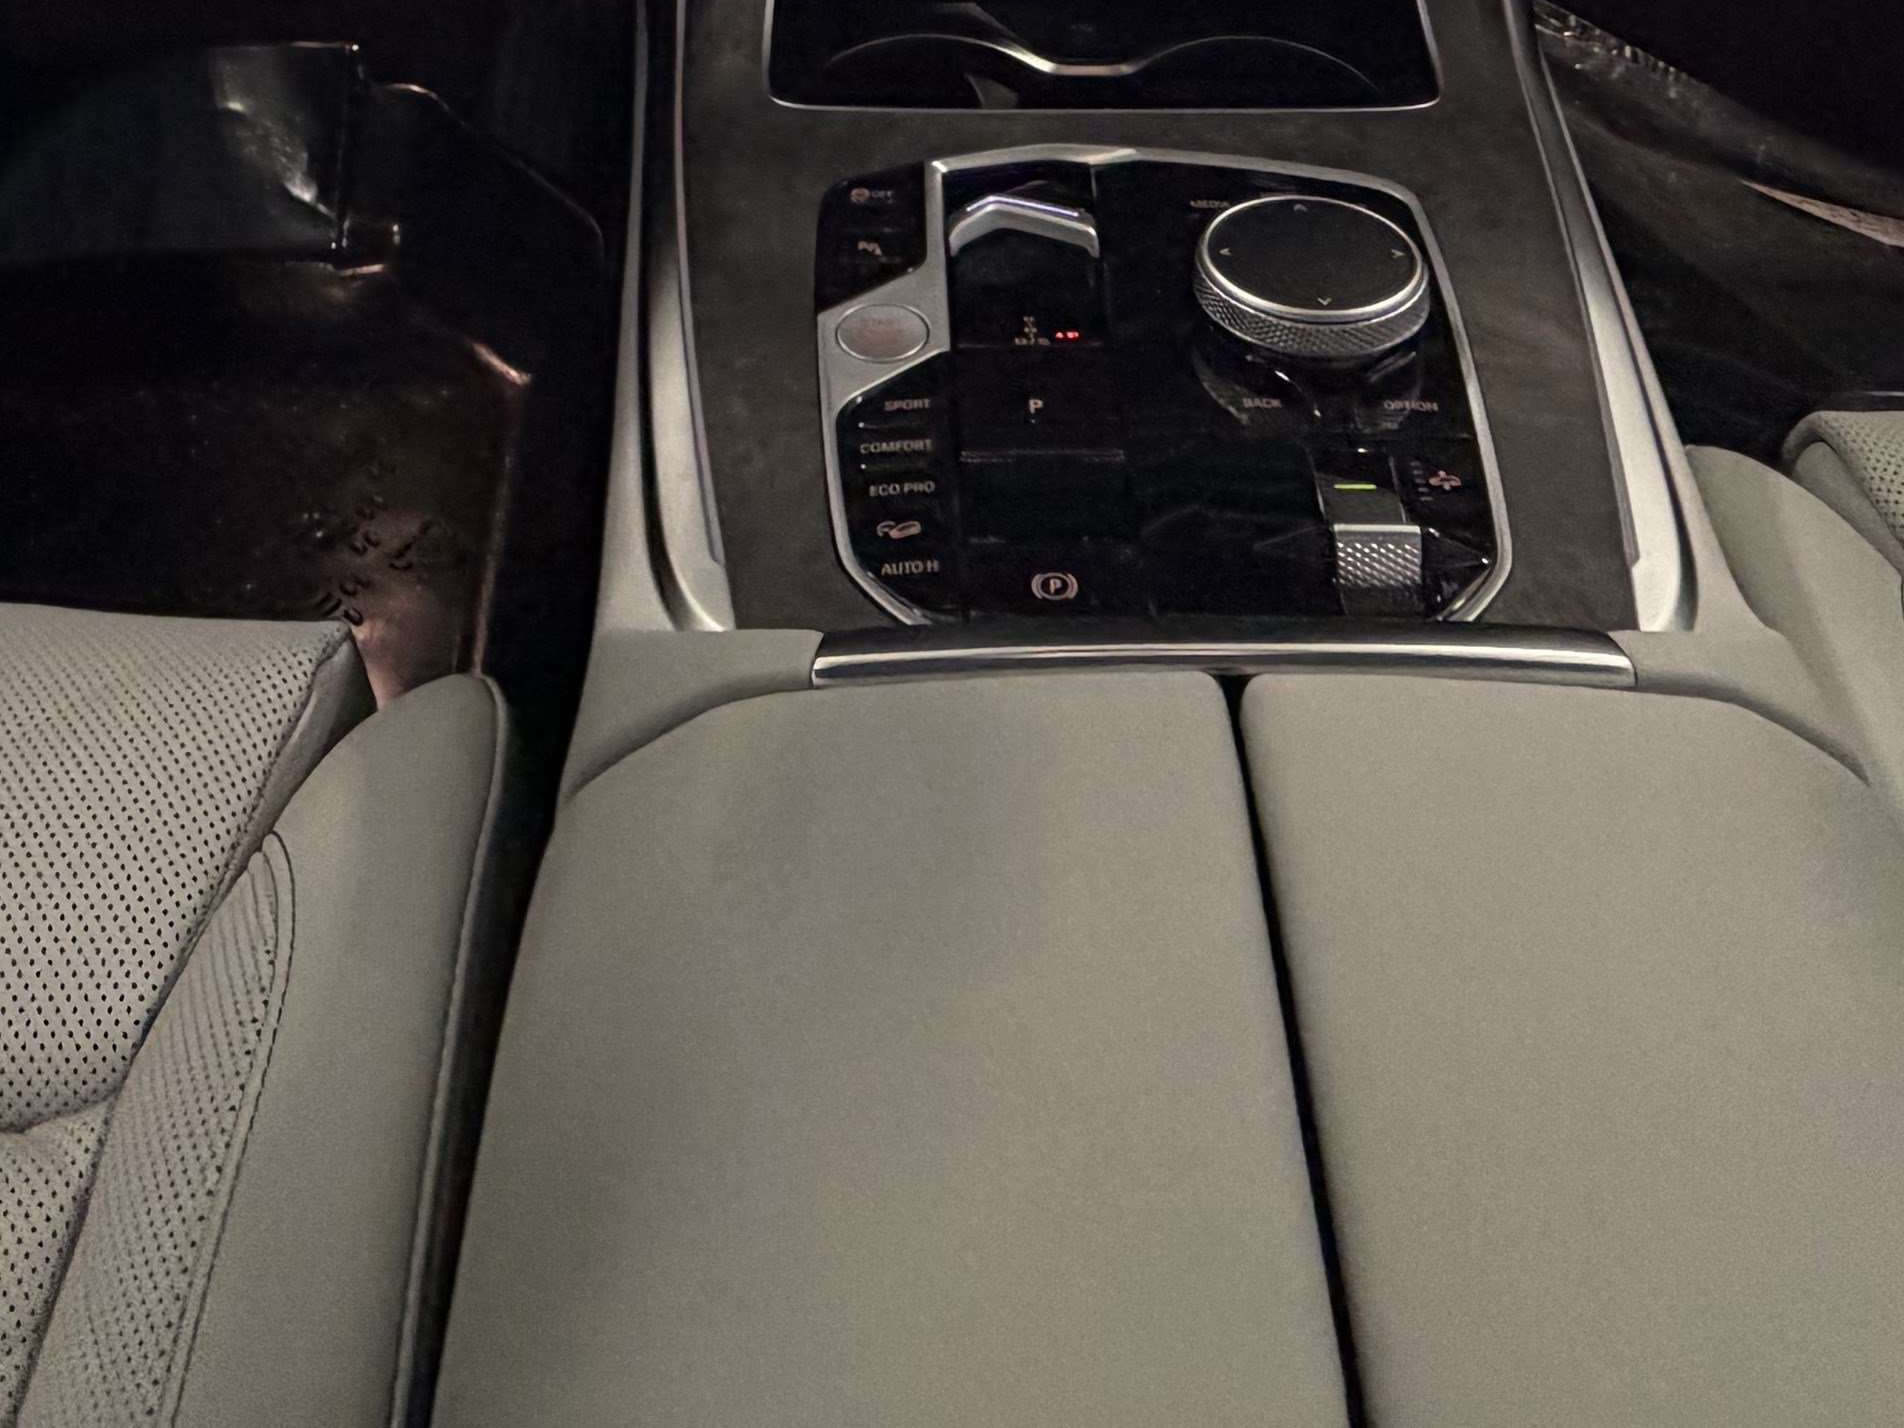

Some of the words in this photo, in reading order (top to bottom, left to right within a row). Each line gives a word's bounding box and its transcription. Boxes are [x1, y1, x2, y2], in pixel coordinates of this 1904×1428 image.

[884, 398, 930, 411] SPORT
[1242, 397, 1282, 409] BACK
[1383, 400, 1439, 412] OPTION
[859, 439, 933, 455] COMFORT
[869, 482, 901, 498] ECO
[903, 480, 936, 495] PRO
[881, 561, 924, 576] AUTO
[926, 560, 941, 574] H
